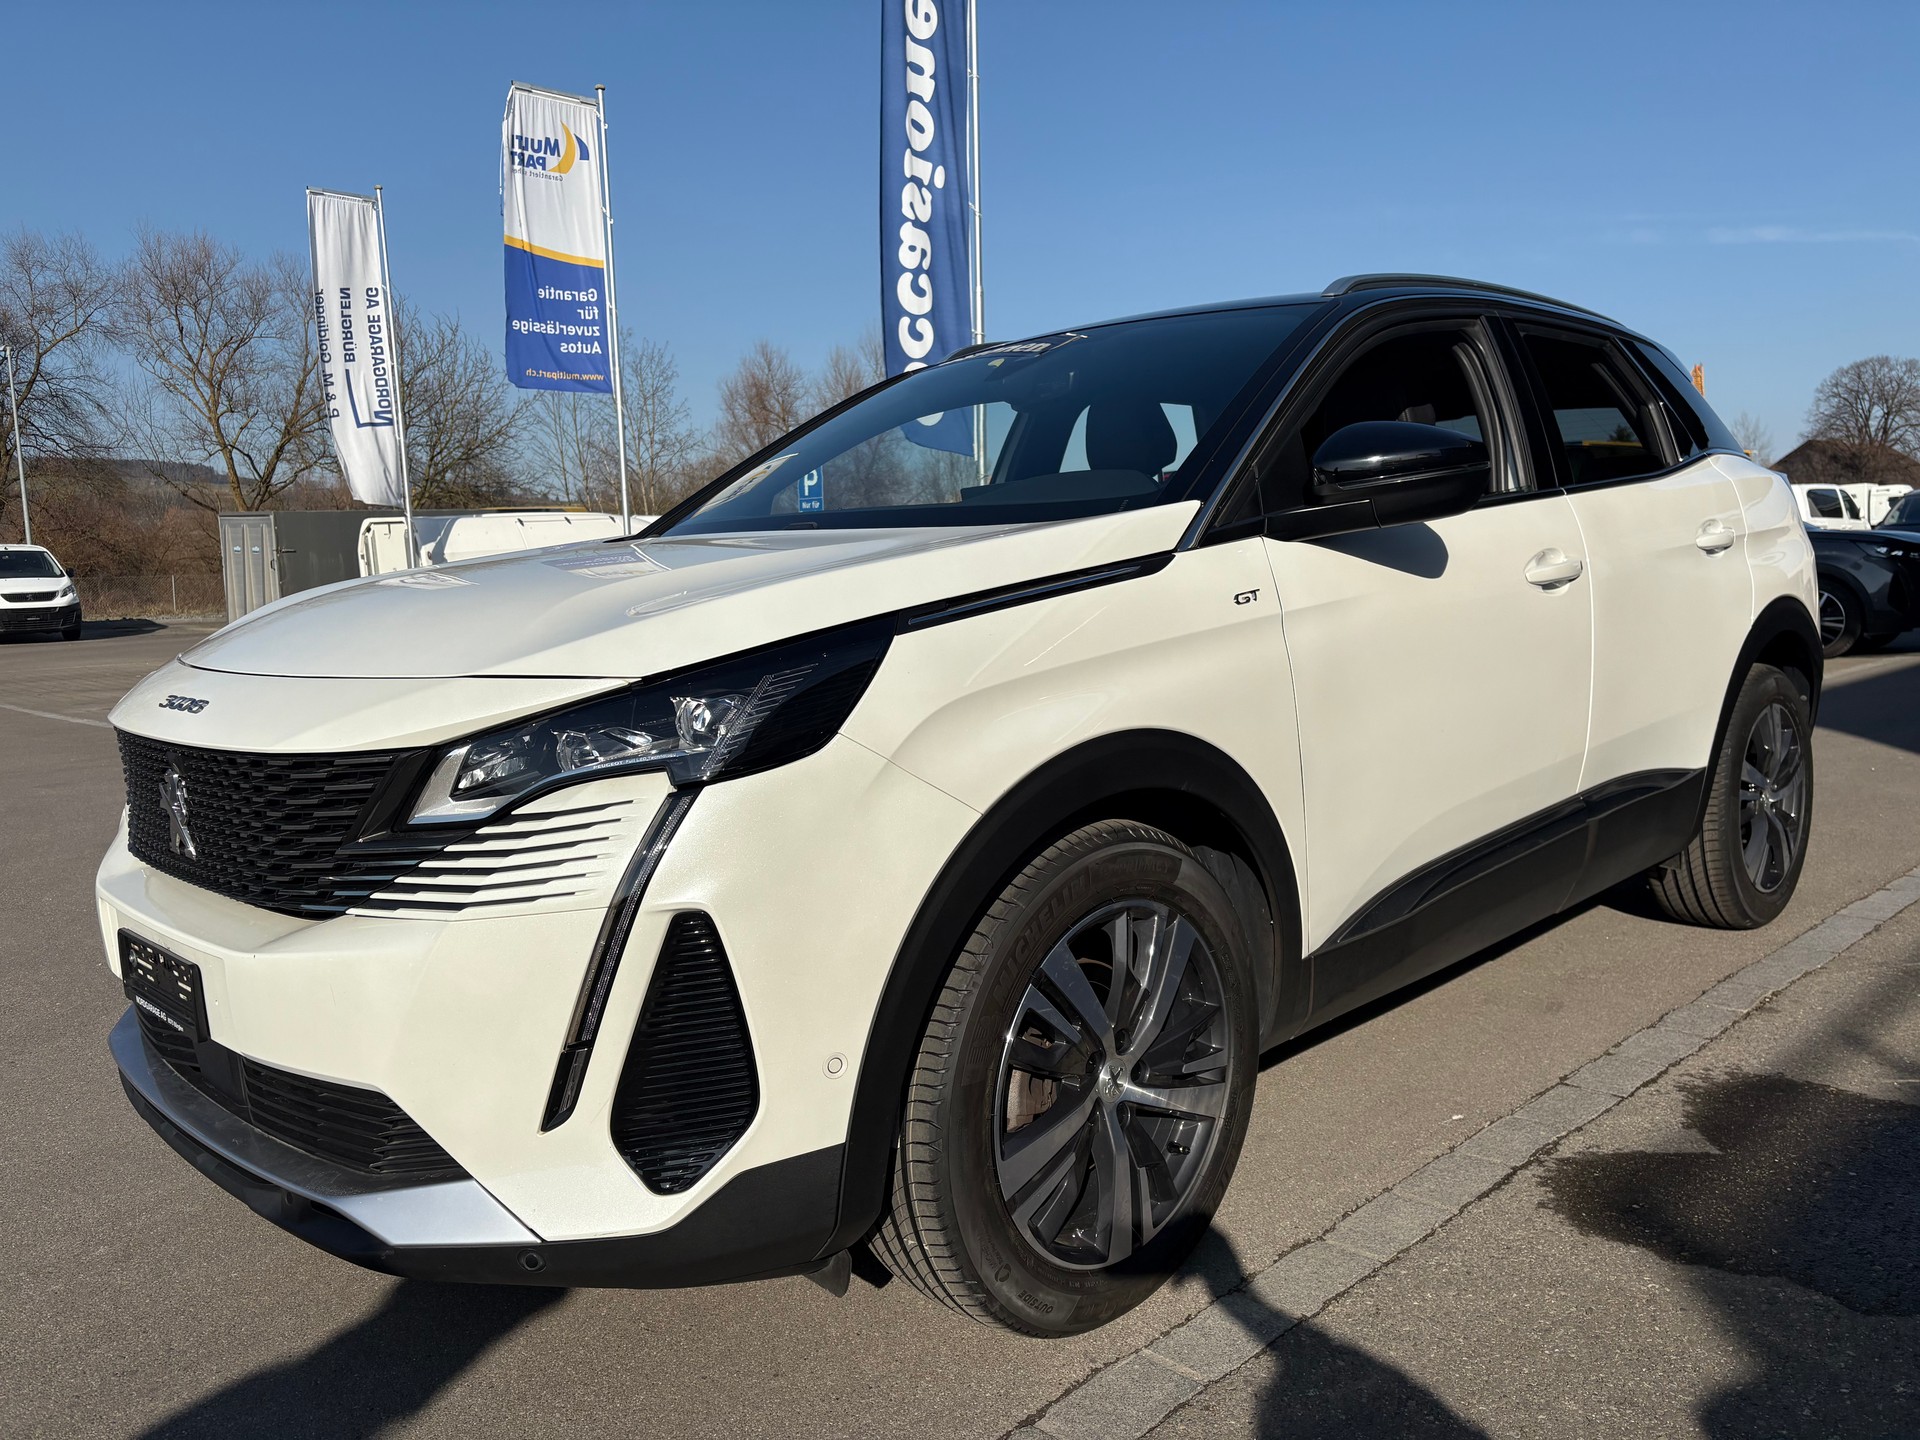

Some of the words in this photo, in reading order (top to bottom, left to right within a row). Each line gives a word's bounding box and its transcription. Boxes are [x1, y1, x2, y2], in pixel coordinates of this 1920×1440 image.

[803, 469, 818, 496] P
[1234, 588, 1260, 606] GT
[159, 694, 210, 714] 3008
[593, 761, 622, 770] PEUGEOT
[1017, 1289, 1054, 1315] OUTSIDE
